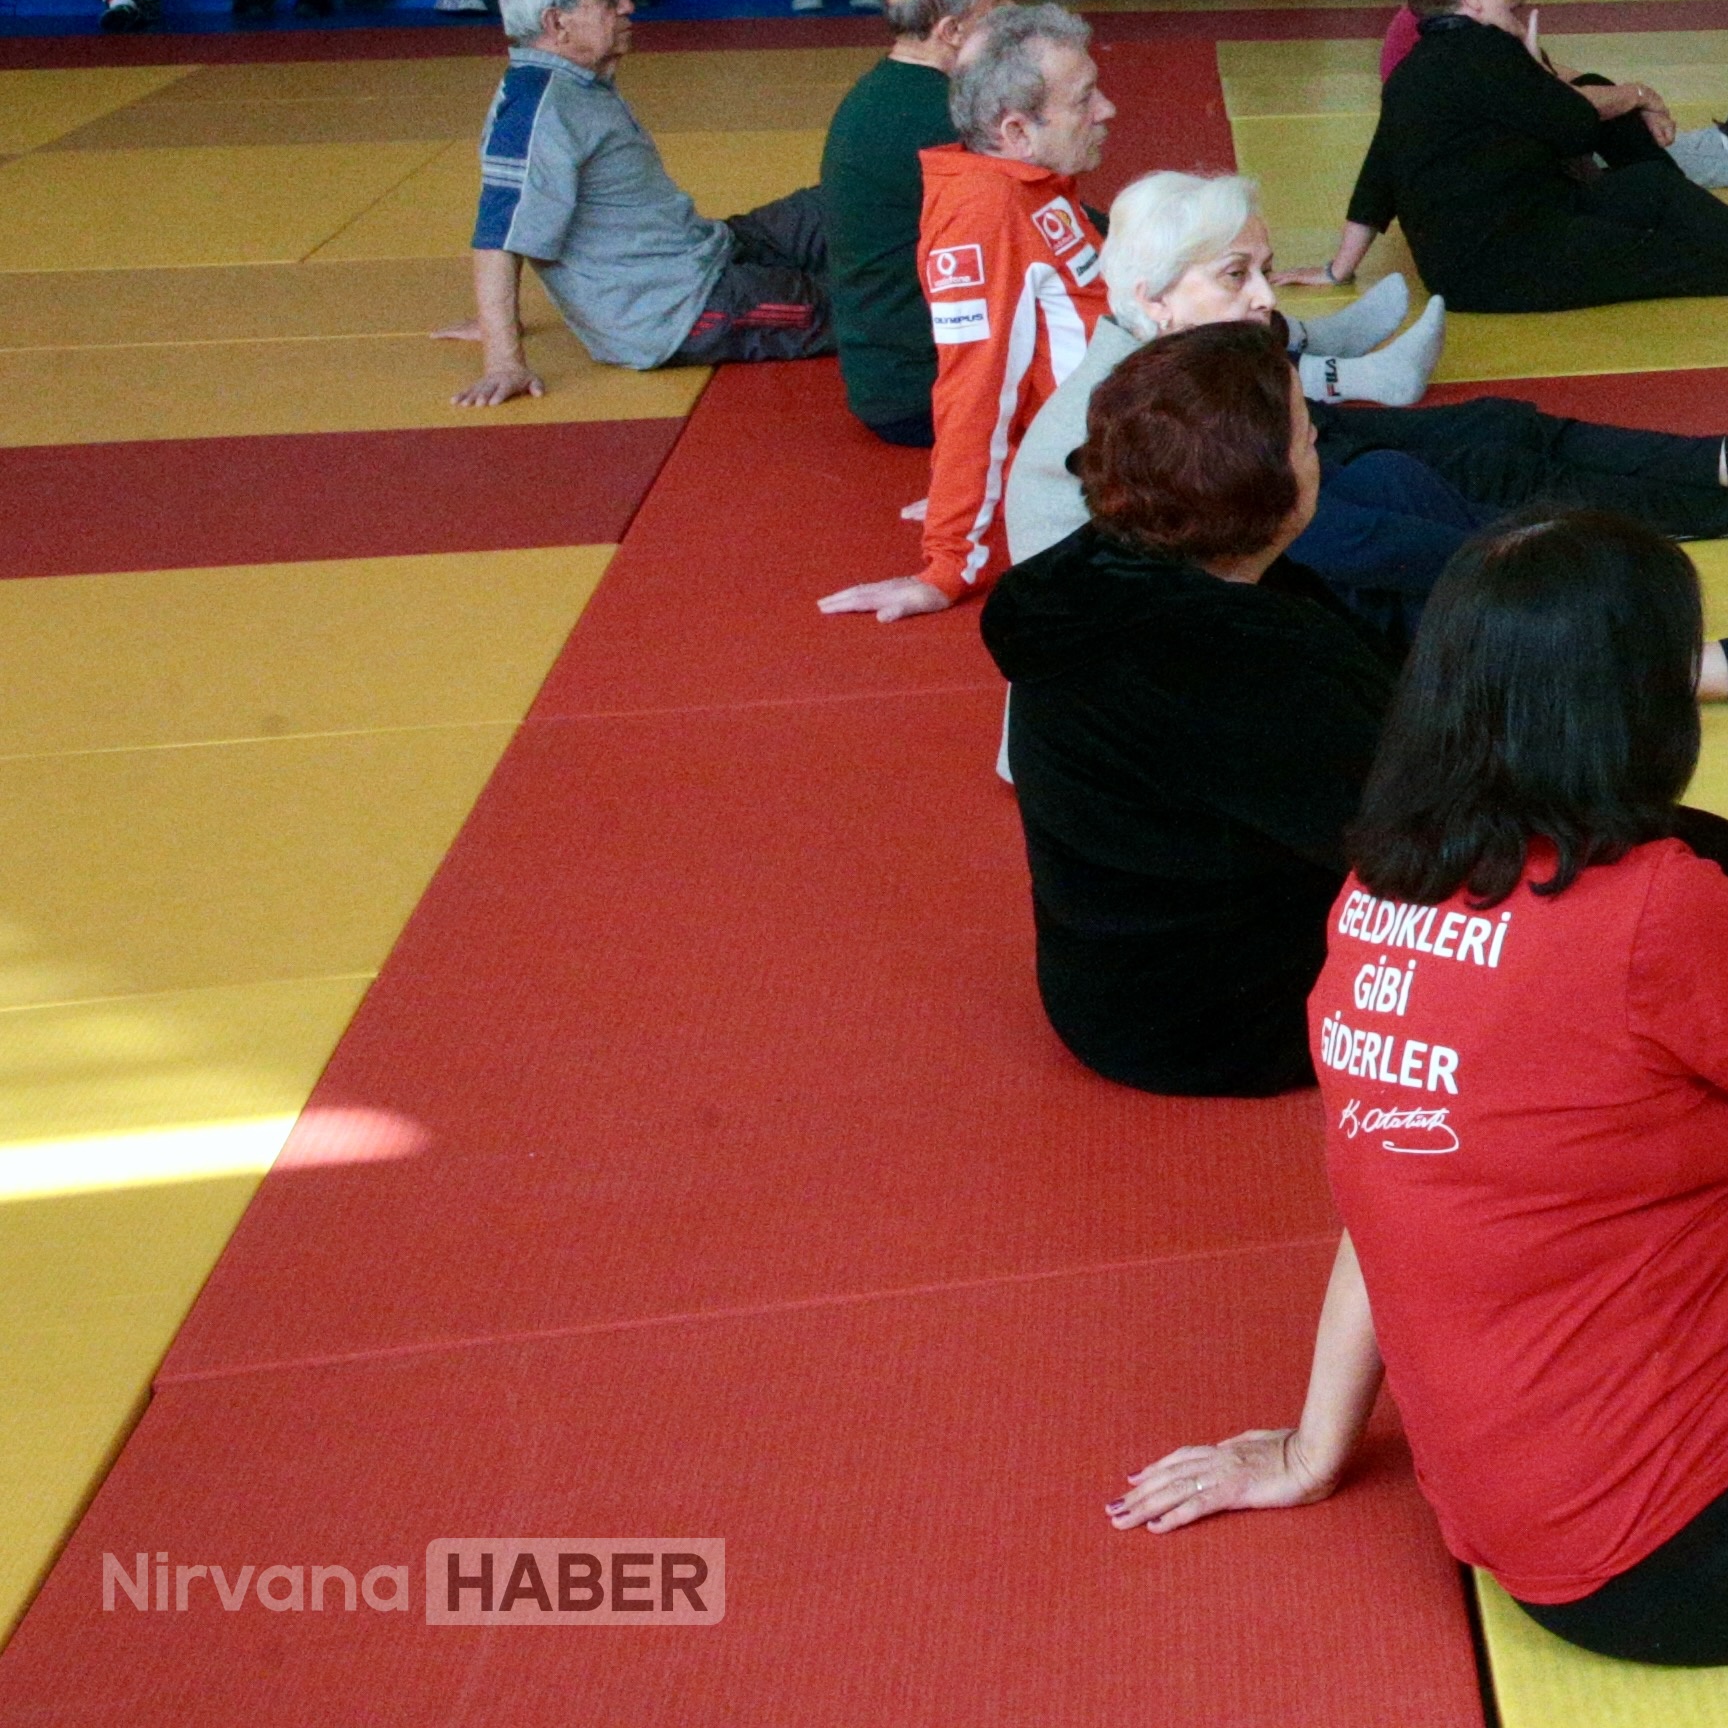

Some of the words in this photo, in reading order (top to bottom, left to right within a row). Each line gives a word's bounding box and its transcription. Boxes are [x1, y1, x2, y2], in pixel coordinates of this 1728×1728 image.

[1325, 358, 1341, 396] FILA
[1353, 954, 1417, 1016] GİBİ
[1321, 1010, 1460, 1095] GİDERLER
